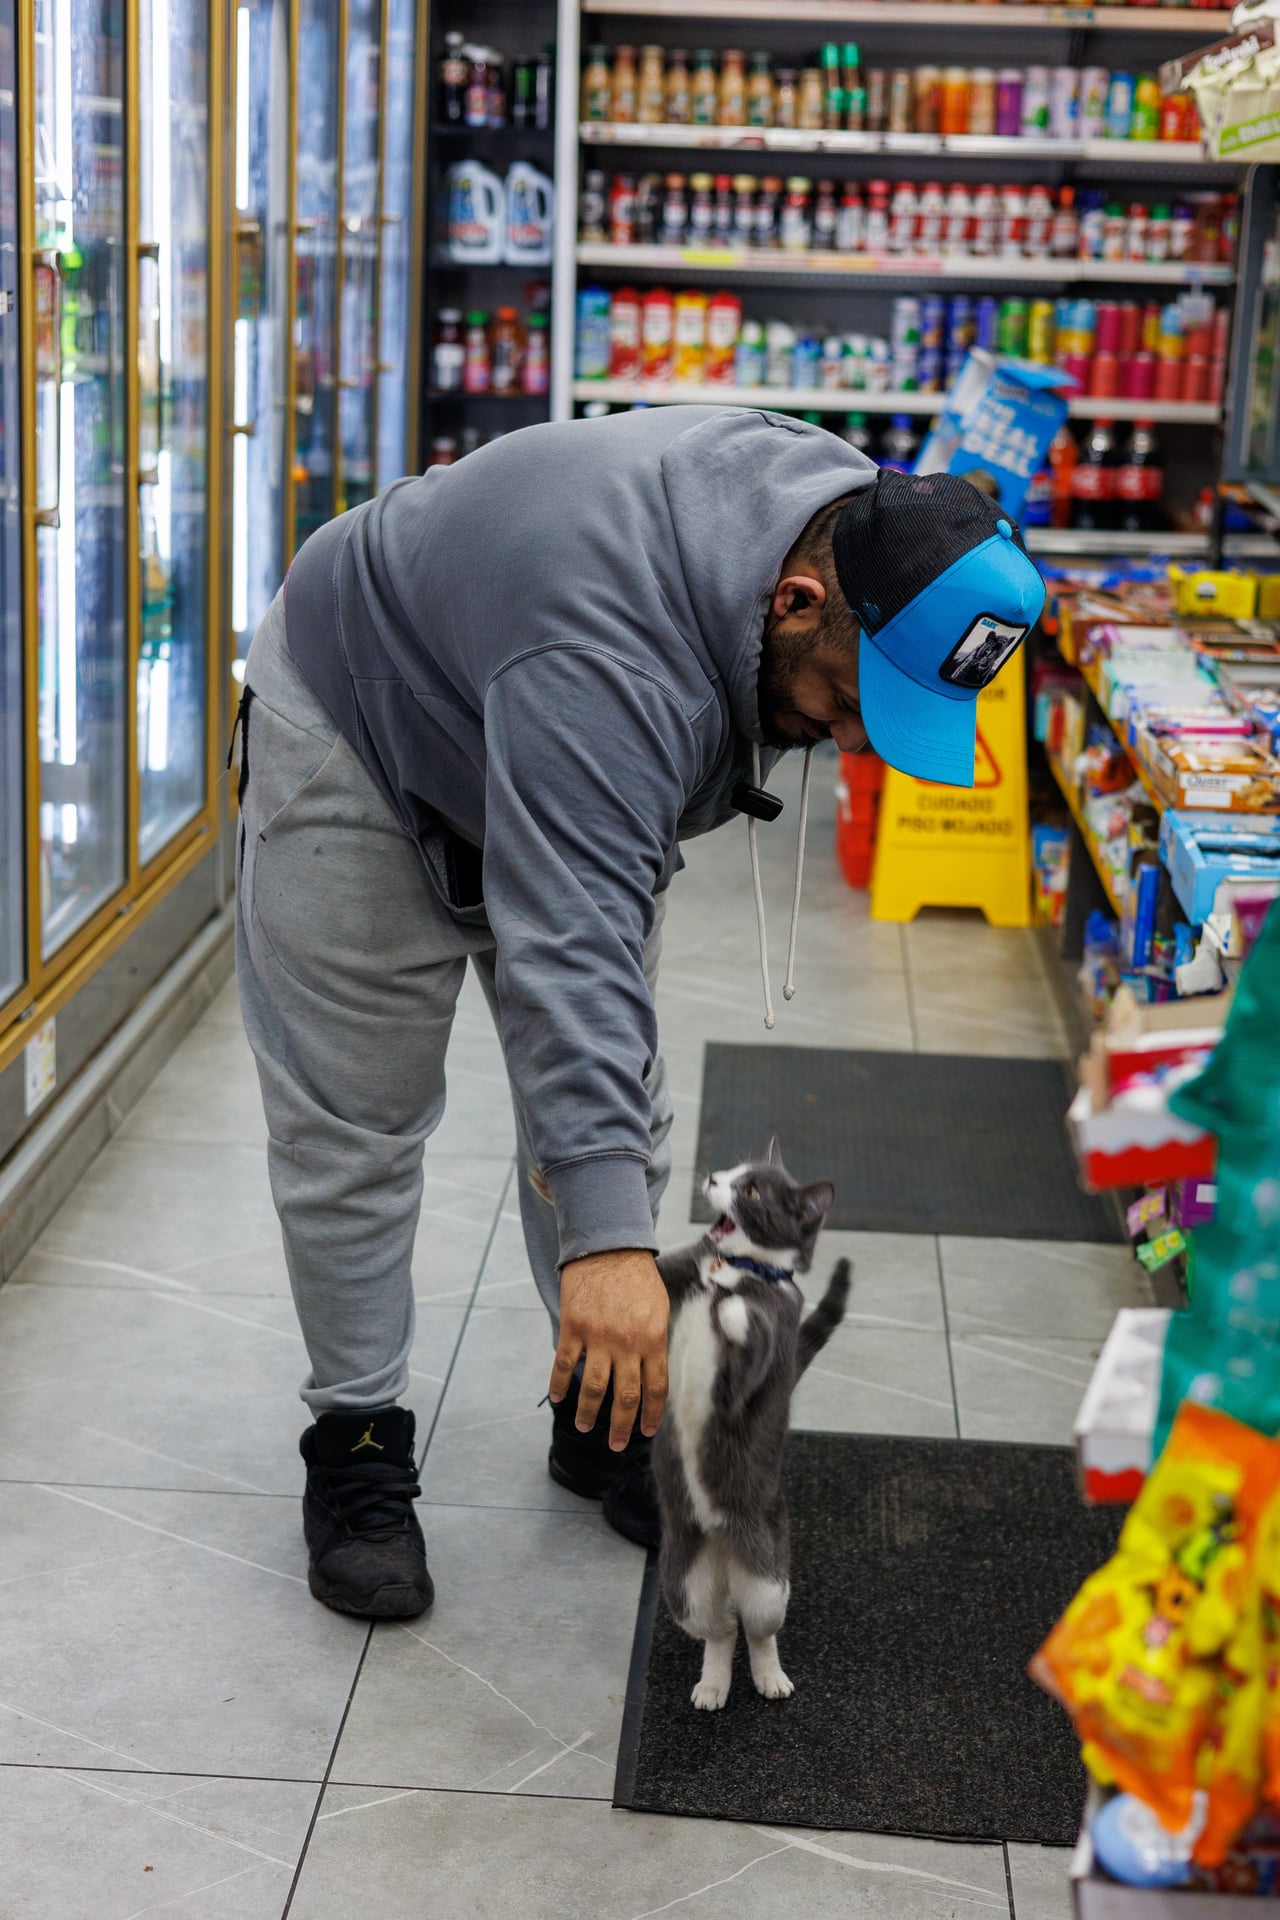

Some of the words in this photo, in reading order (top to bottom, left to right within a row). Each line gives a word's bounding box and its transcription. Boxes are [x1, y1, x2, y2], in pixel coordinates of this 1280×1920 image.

[976, 412, 1038, 459] REAL
[964, 432, 1031, 478] DEAL
[917, 795, 995, 814] CUIDADO
[898, 816, 935, 832] PISO
[942, 818, 1013, 836] MOJADO
